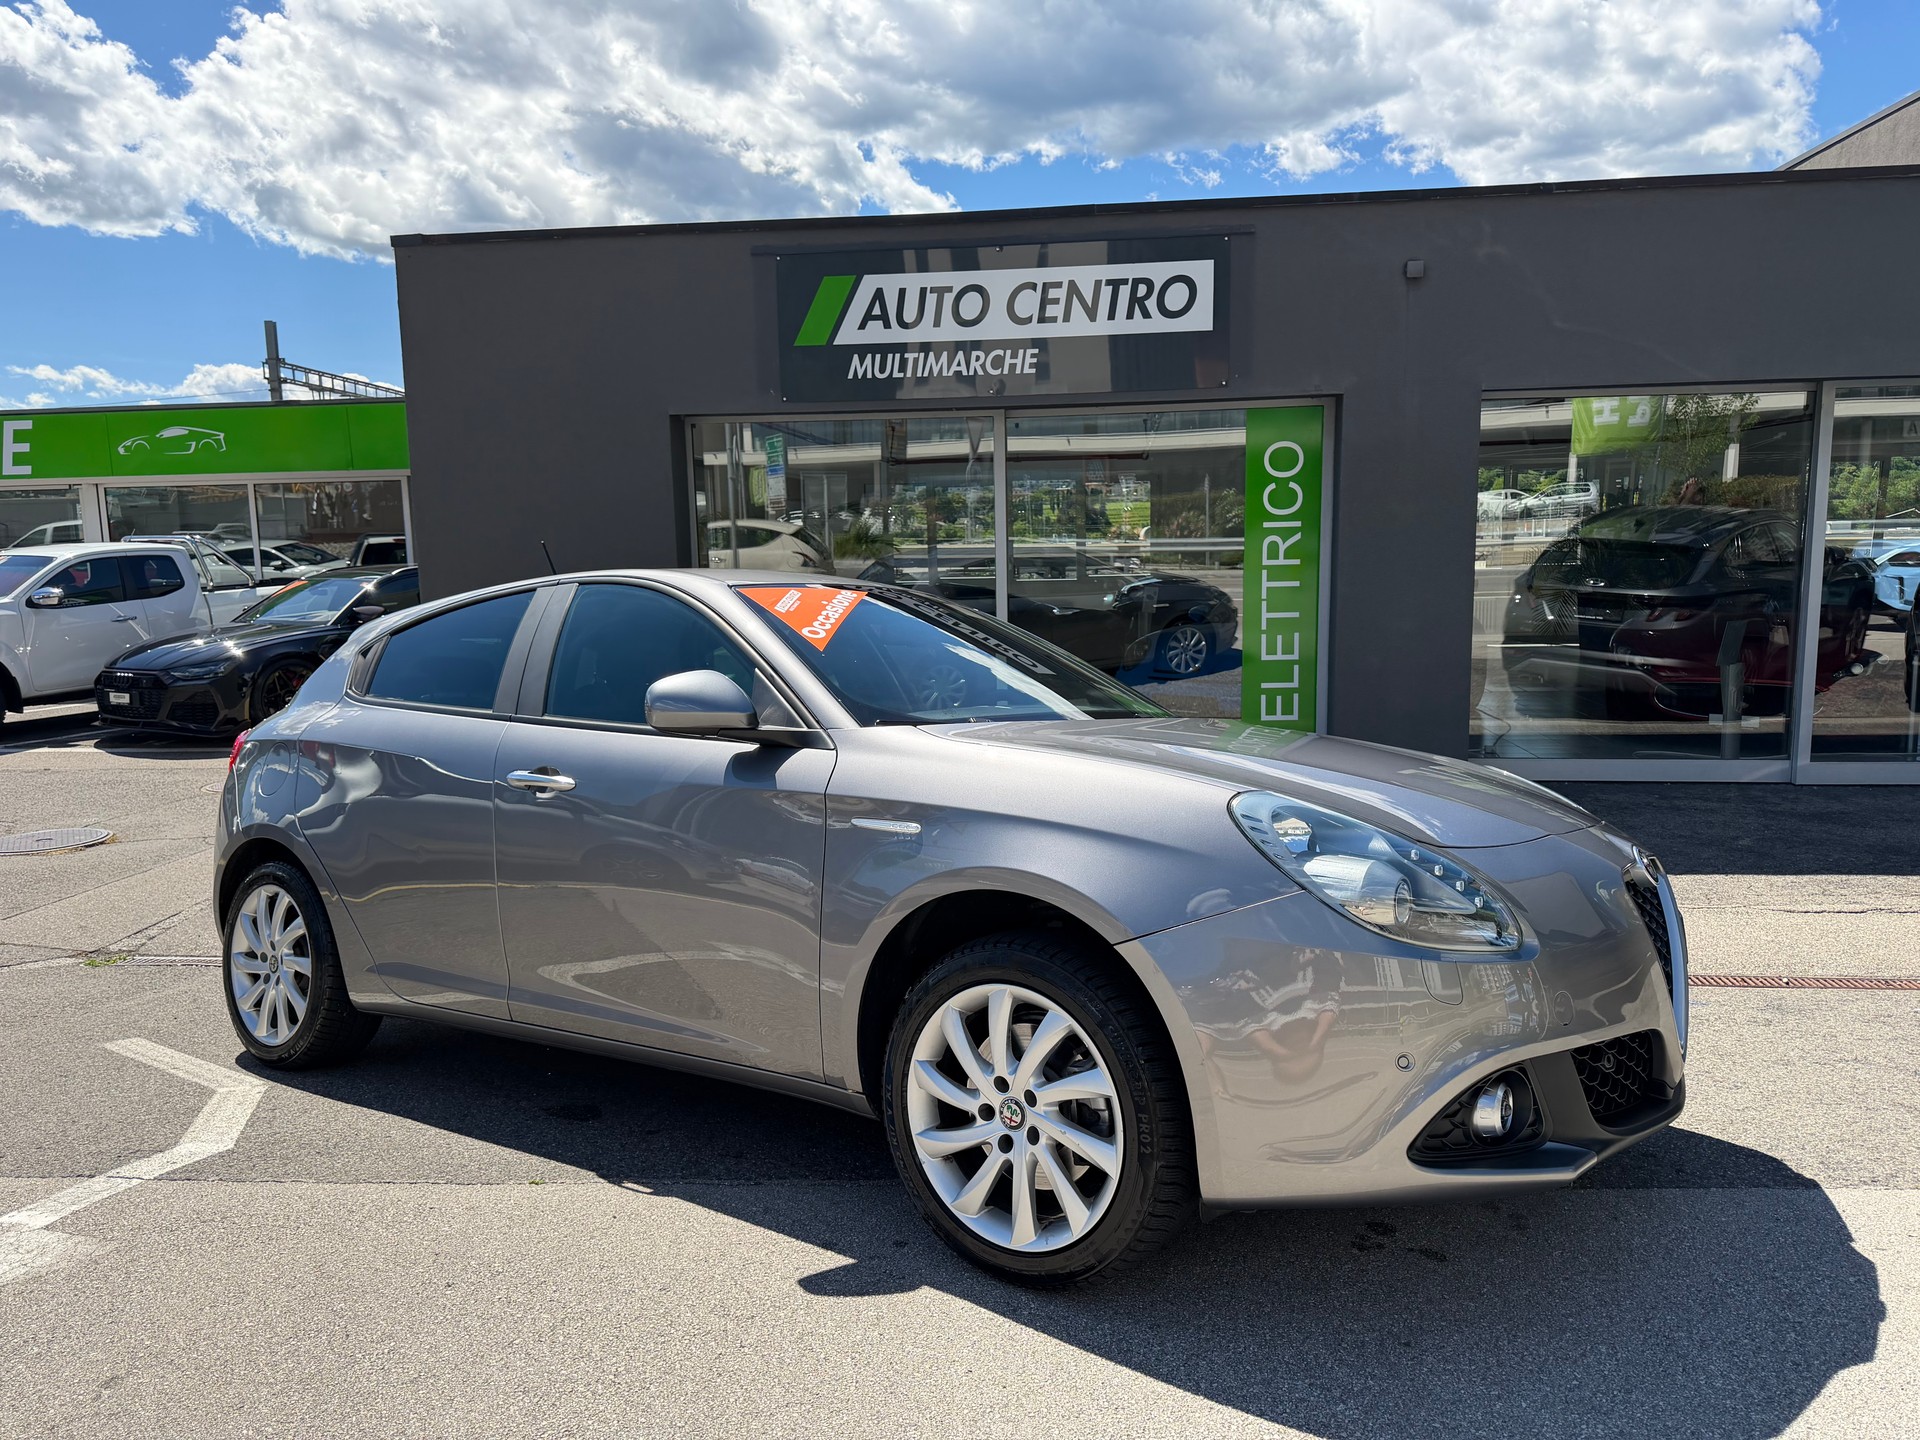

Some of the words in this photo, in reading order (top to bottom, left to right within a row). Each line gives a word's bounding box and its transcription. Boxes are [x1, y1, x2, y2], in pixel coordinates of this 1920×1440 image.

[857, 283, 991, 331] AUTO
[1006, 274, 1198, 326] CENTRO
[847, 348, 1040, 380] MULTIMARCHE
[1260, 440, 1305, 721] ELETTRICO
[801, 590, 858, 639] Occasione
